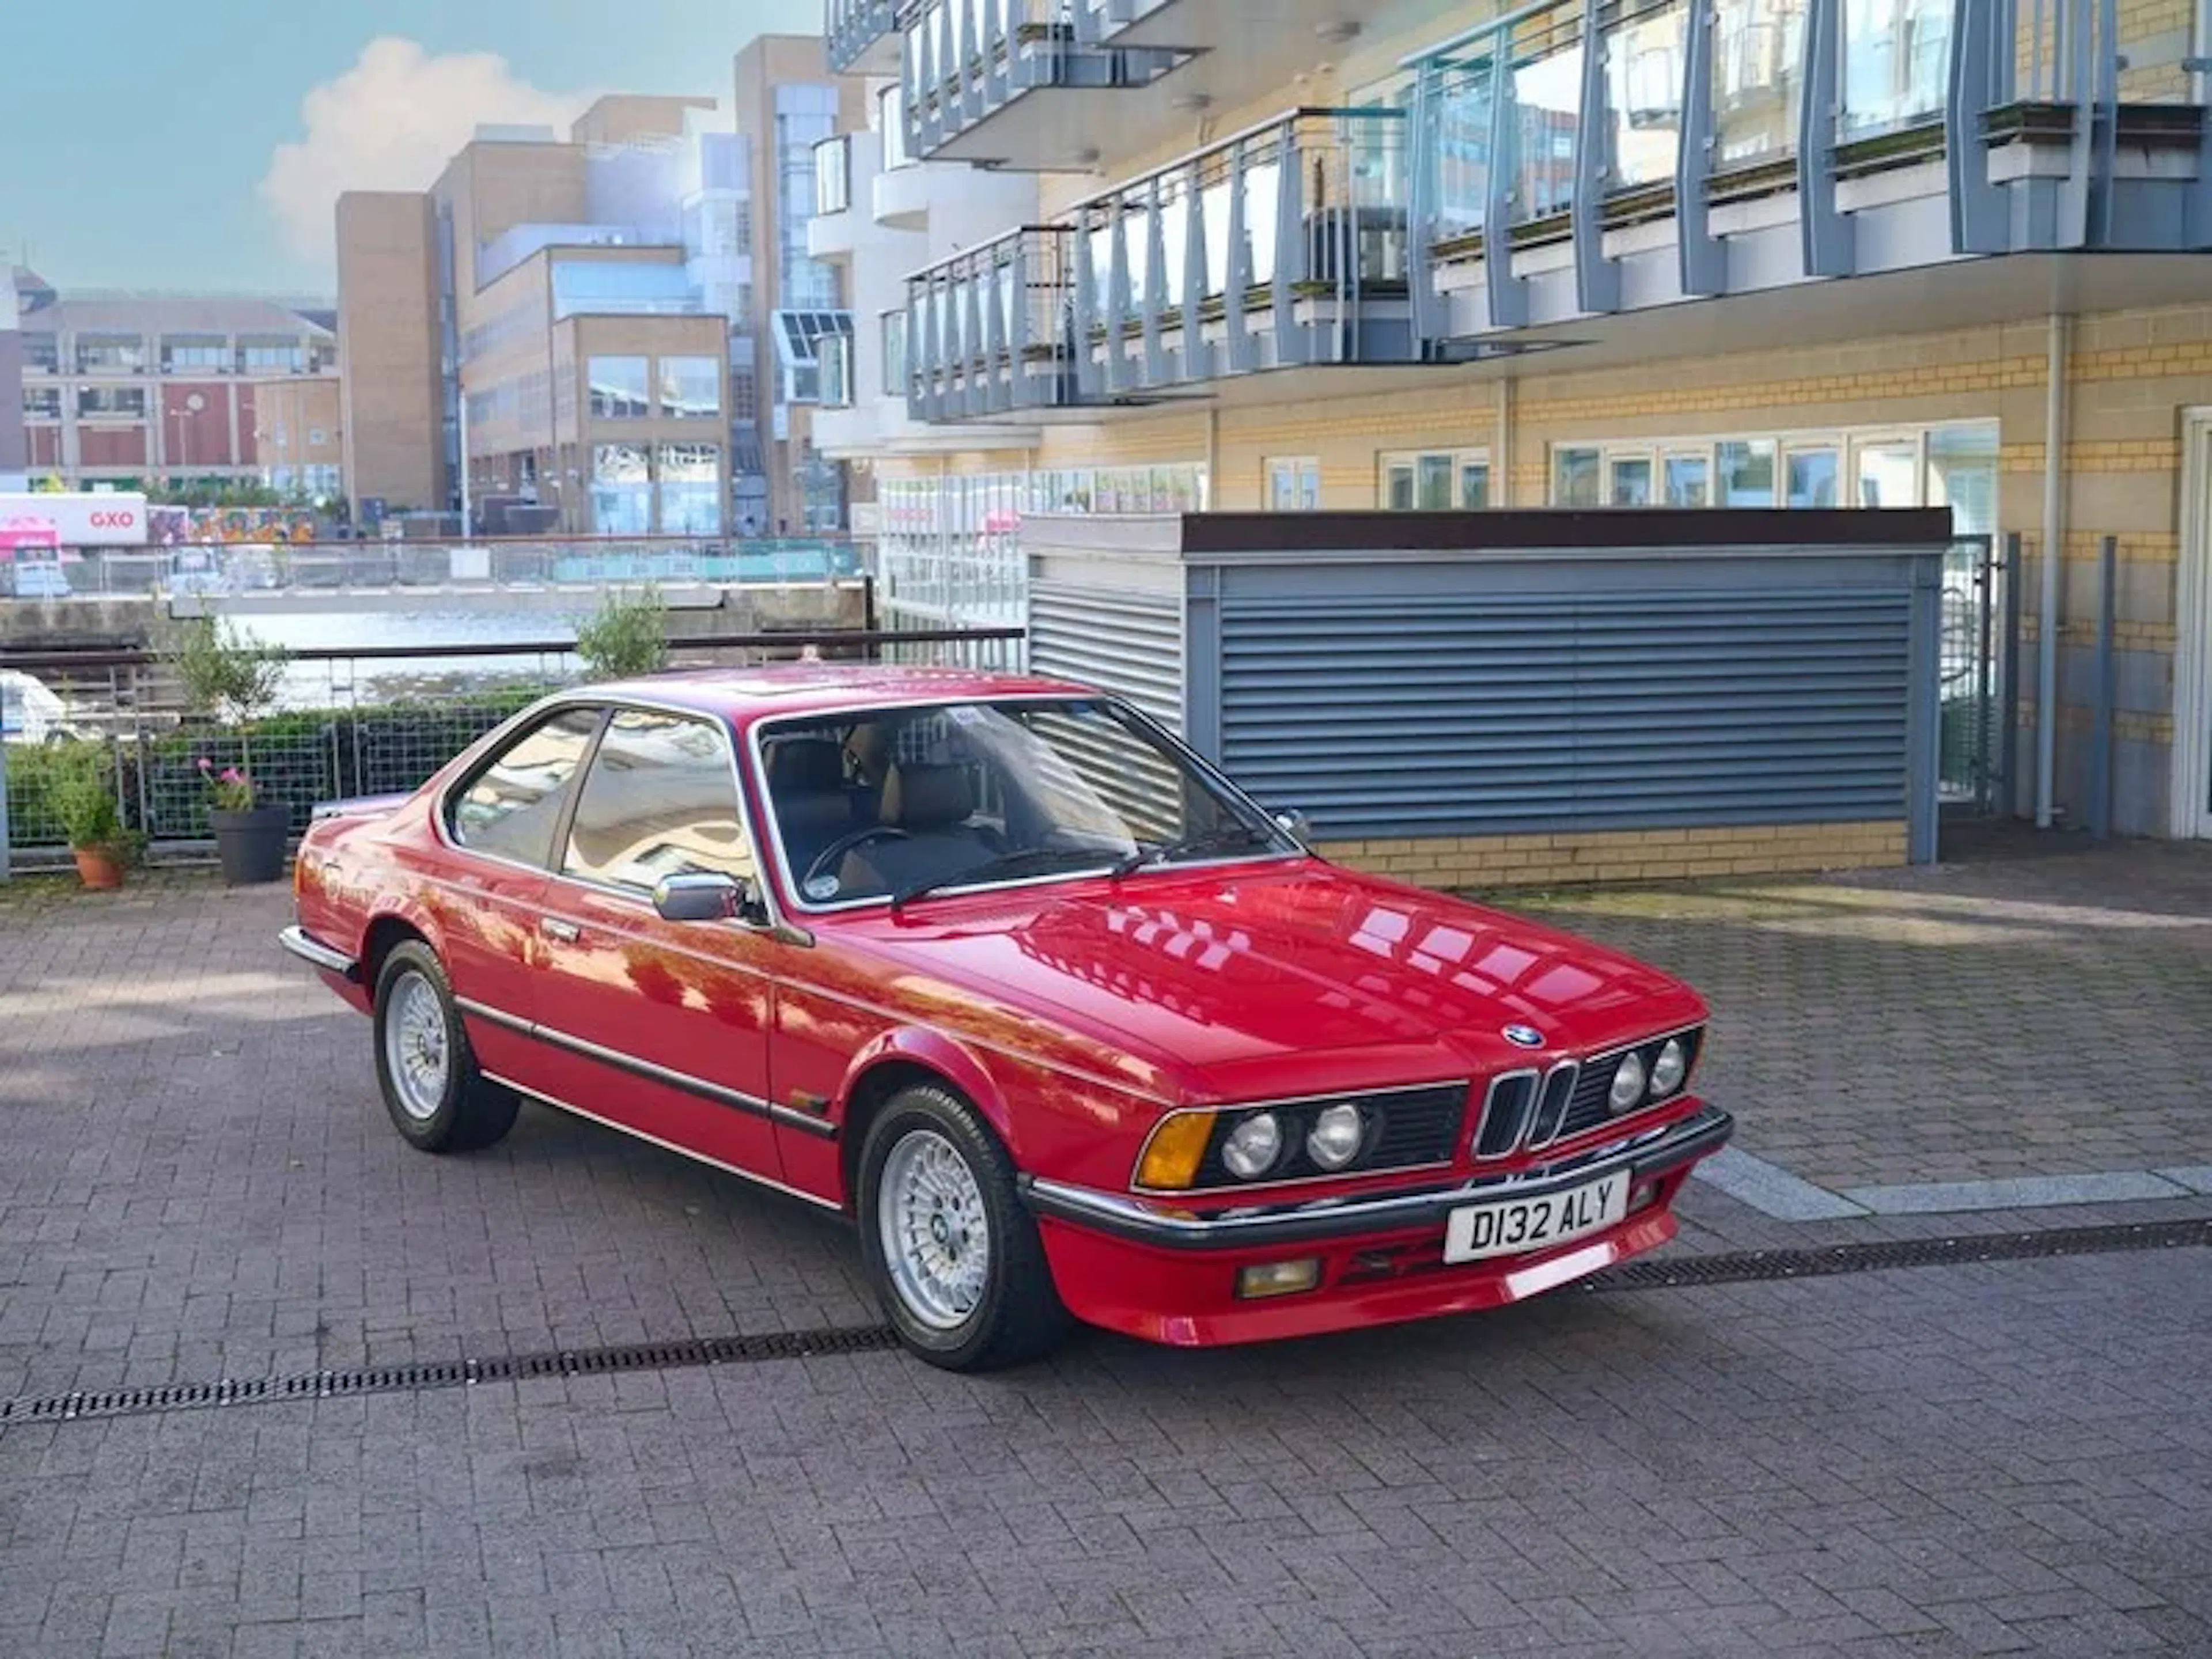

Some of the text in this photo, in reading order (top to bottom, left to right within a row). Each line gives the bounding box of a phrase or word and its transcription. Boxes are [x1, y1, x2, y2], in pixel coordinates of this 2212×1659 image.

[90, 511, 134, 528] GXO
[1471, 1181, 1612, 1249] D132 ALY
